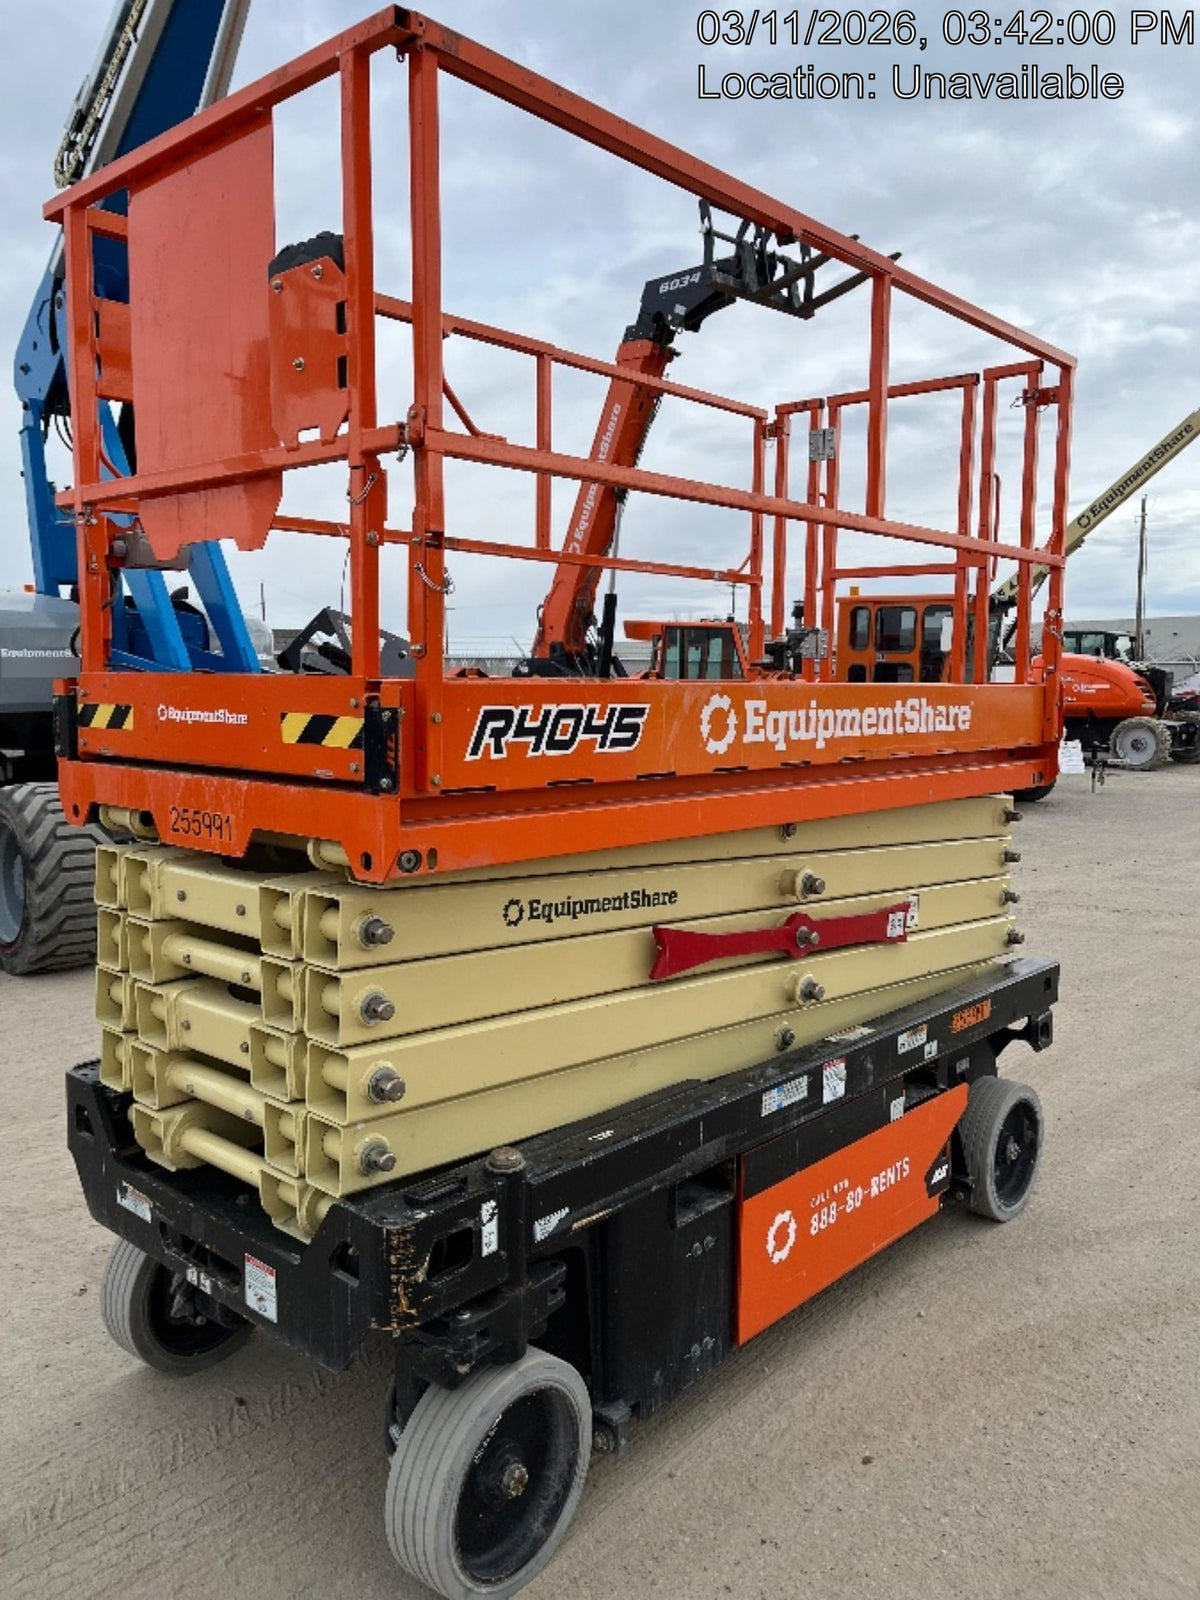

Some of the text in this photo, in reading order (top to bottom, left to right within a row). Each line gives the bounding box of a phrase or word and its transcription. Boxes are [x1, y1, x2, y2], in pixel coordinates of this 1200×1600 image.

[659, 272, 701, 294] 6034
[573, 403, 621, 542] EquipmtShare
[1089, 424, 1194, 518] EquipmentShare
[0, 648, 75, 659] EquipmentS
[168, 706, 248, 725] EquipmentShare
[464, 704, 651, 761] R4045
[743, 698, 972, 751] EquipmentShare
[170, 806, 232, 842] 255991
[528, 889, 678, 923] EquipmentShare
[810, 1157, 910, 1236] 888-80-RENTS
